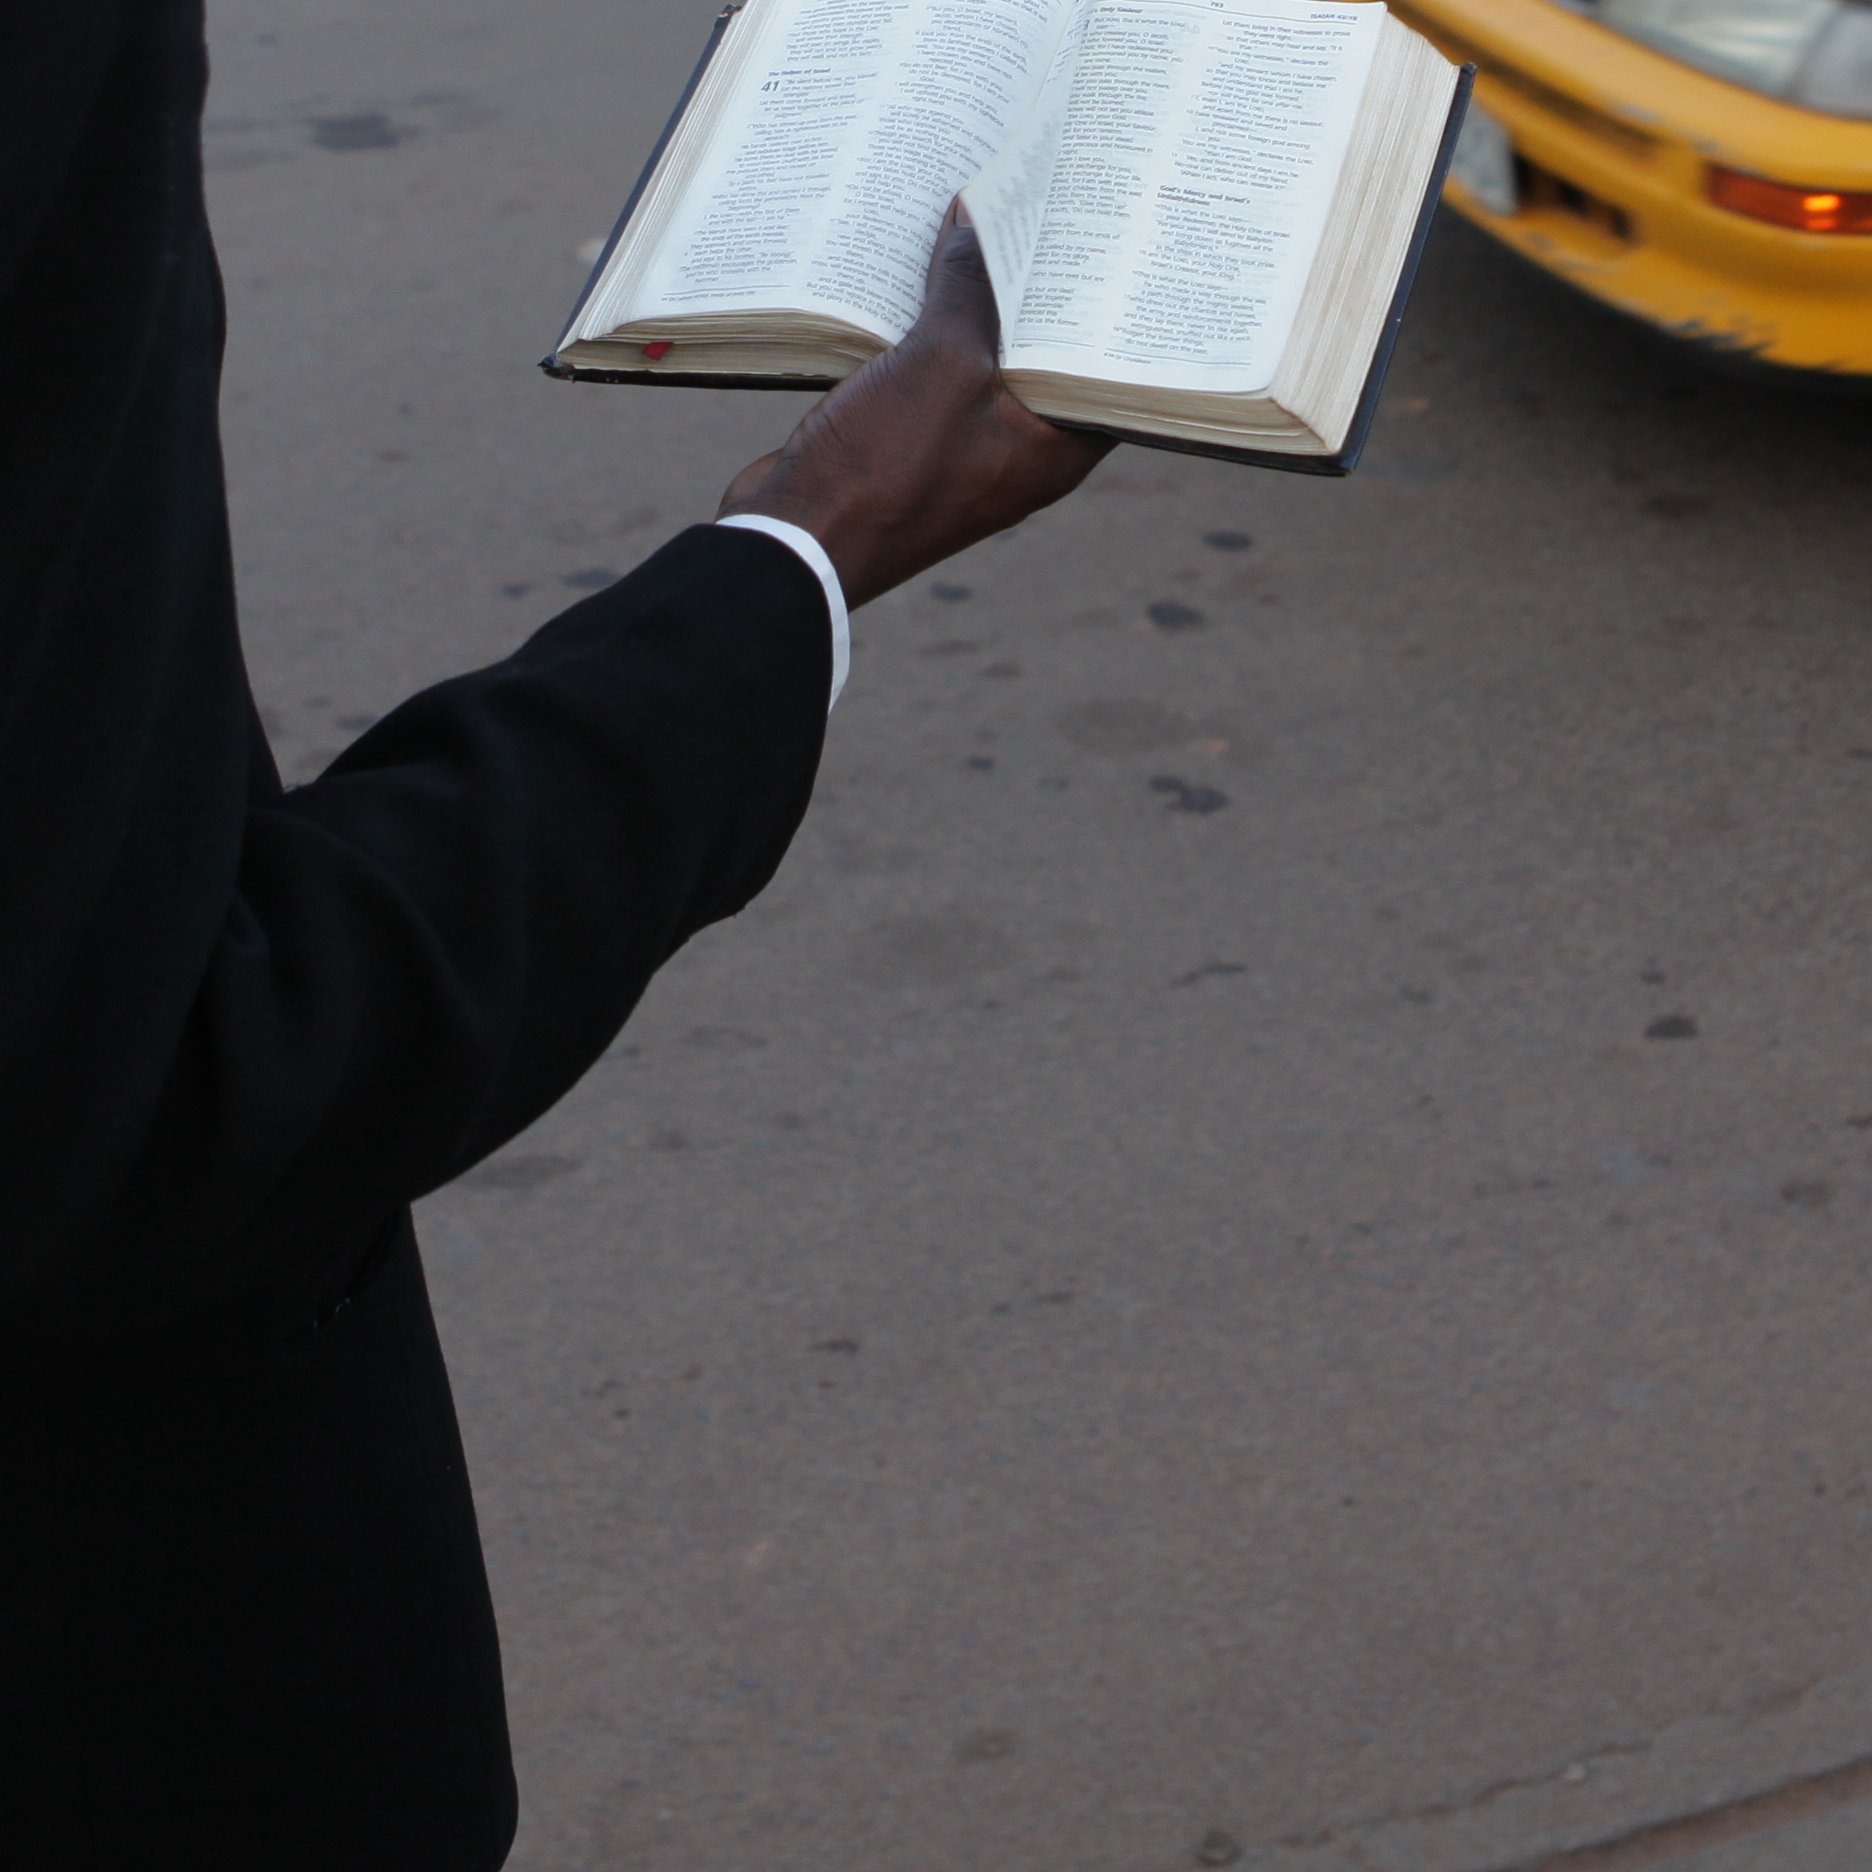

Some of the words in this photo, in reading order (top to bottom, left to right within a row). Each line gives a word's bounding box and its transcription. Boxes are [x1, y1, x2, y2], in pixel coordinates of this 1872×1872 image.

[760, 79, 781, 93] 41
[1157, 192, 1210, 206] Unfaithfulness
[1183, 188, 1206, 198] Mercy
